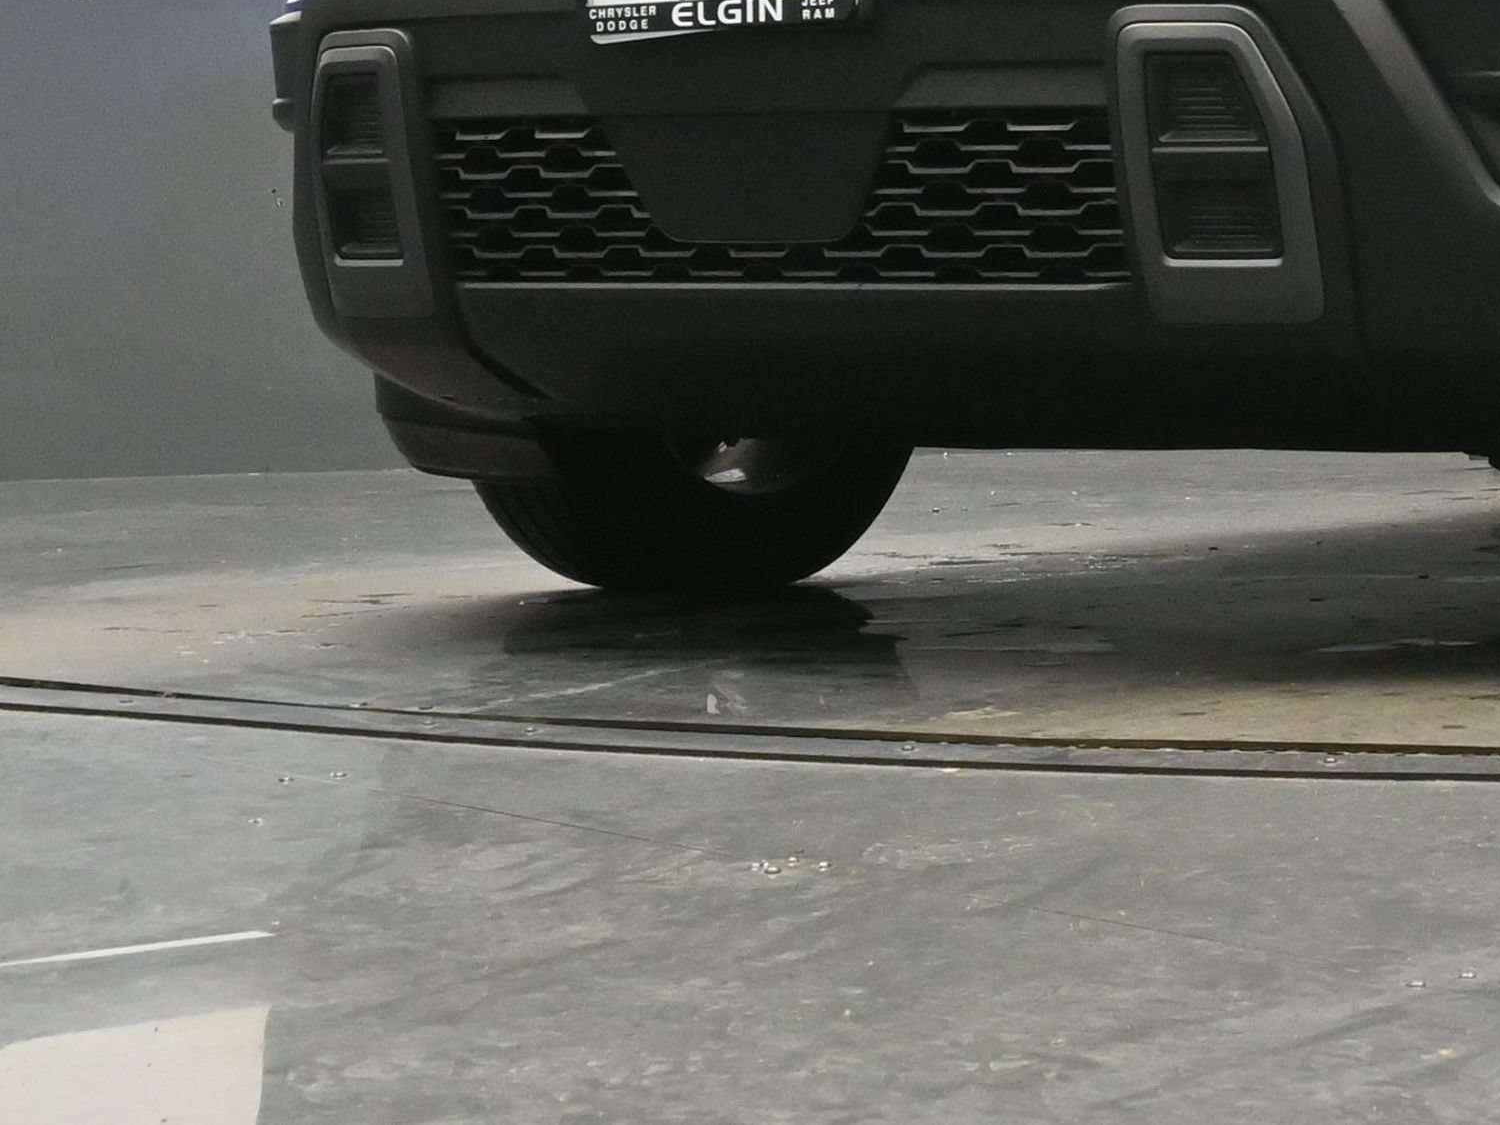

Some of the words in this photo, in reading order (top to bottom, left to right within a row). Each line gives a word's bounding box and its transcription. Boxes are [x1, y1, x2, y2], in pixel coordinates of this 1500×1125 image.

[588, 5, 657, 20] CHRYSLER
[802, 7, 836, 21] RAM
[596, 19, 649, 32] DODGE
